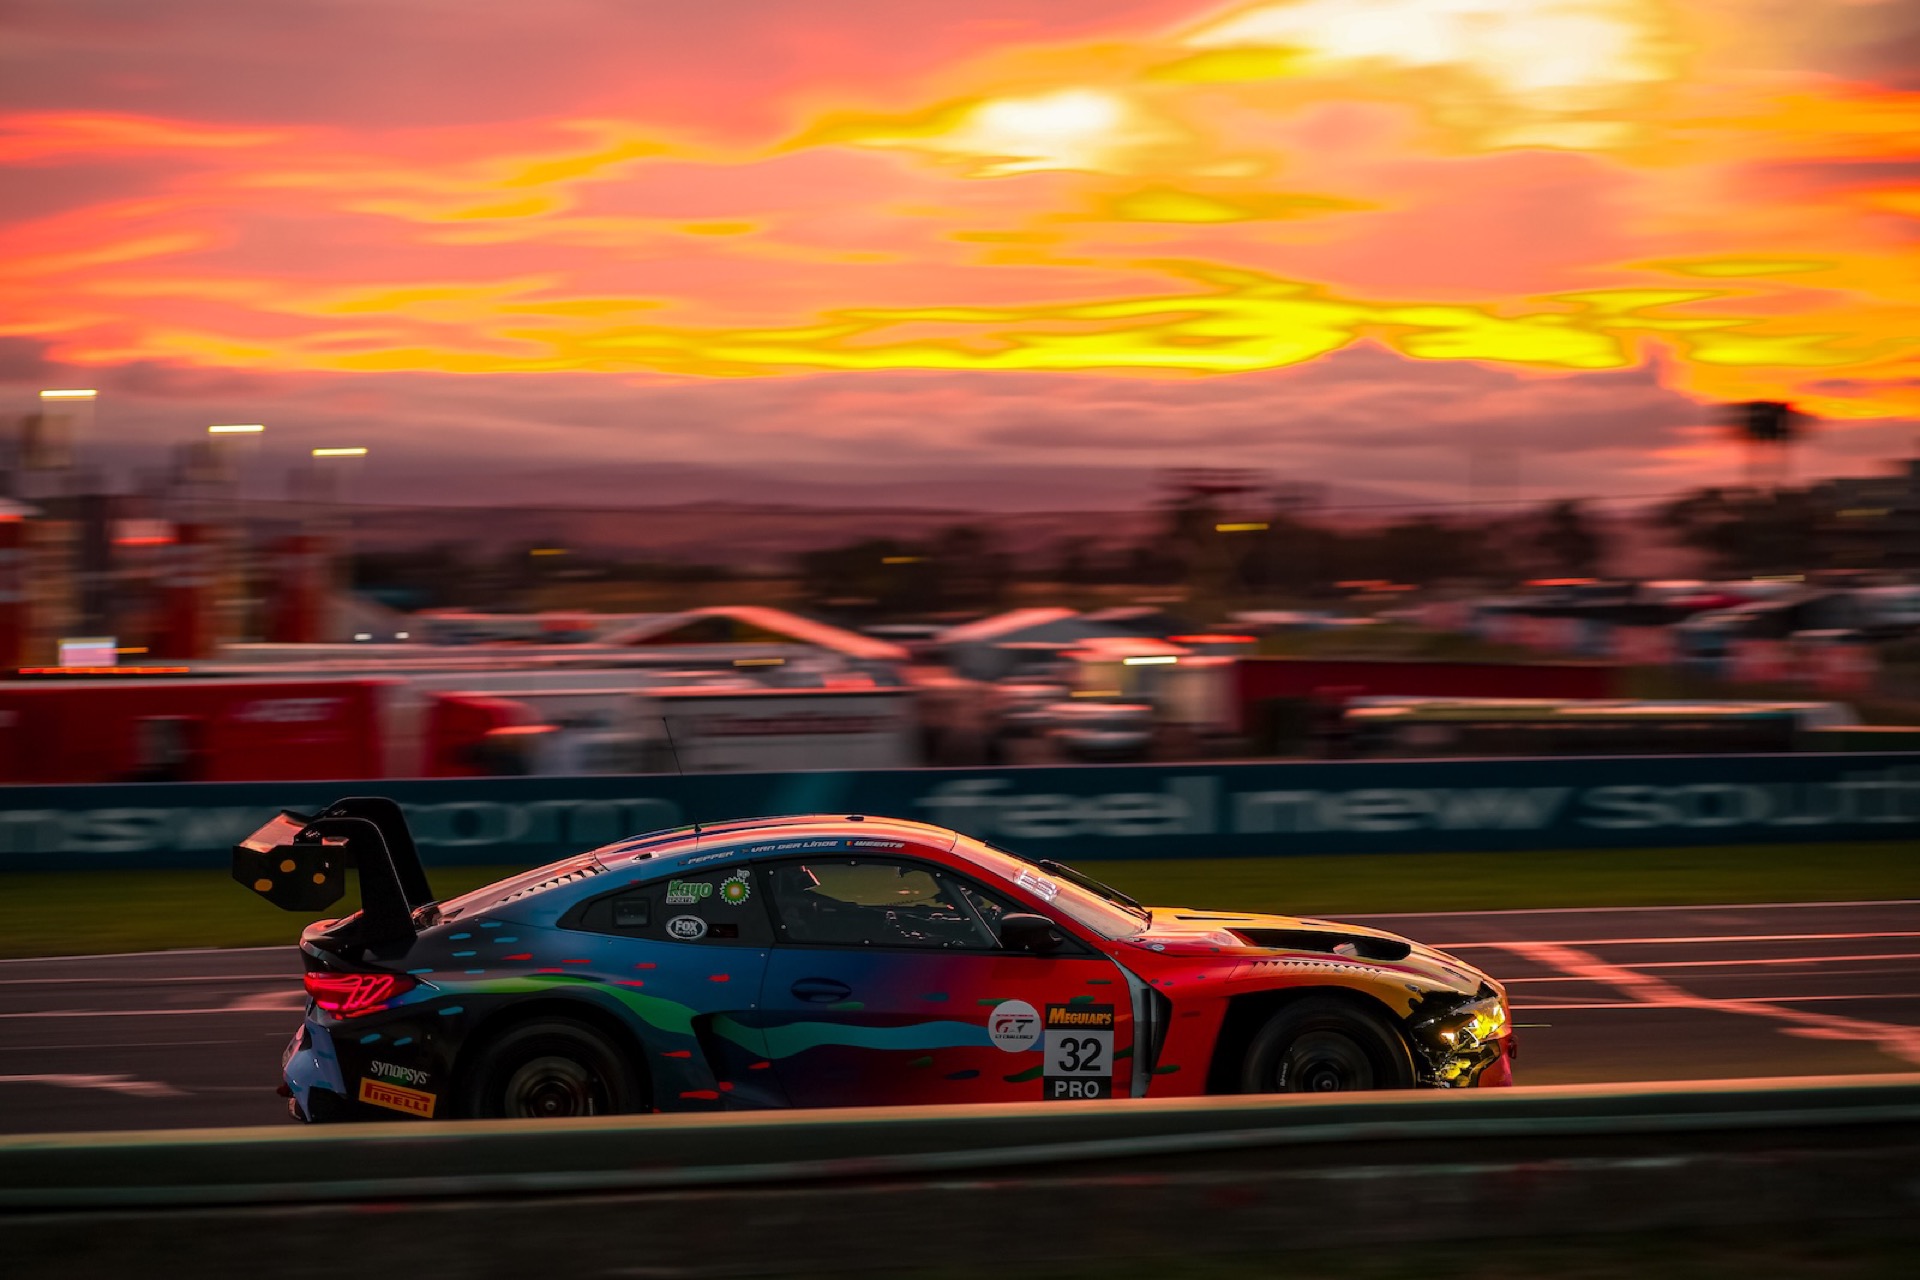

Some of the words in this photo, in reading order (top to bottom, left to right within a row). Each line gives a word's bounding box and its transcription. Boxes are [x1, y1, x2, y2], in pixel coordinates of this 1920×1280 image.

[914, 777, 1223, 836] feel
[1231, 788, 1575, 834] new
[687, 851, 735, 864] PEPPER
[750, 844, 776, 853] VAN
[777, 842, 802, 850] DER
[668, 880, 714, 904] Kayo
[675, 920, 699, 931] FOX
[1058, 1038, 1102, 1071] 32
[364, 1082, 431, 1113] PIRELLI
[1054, 1080, 1100, 1099] PRO
